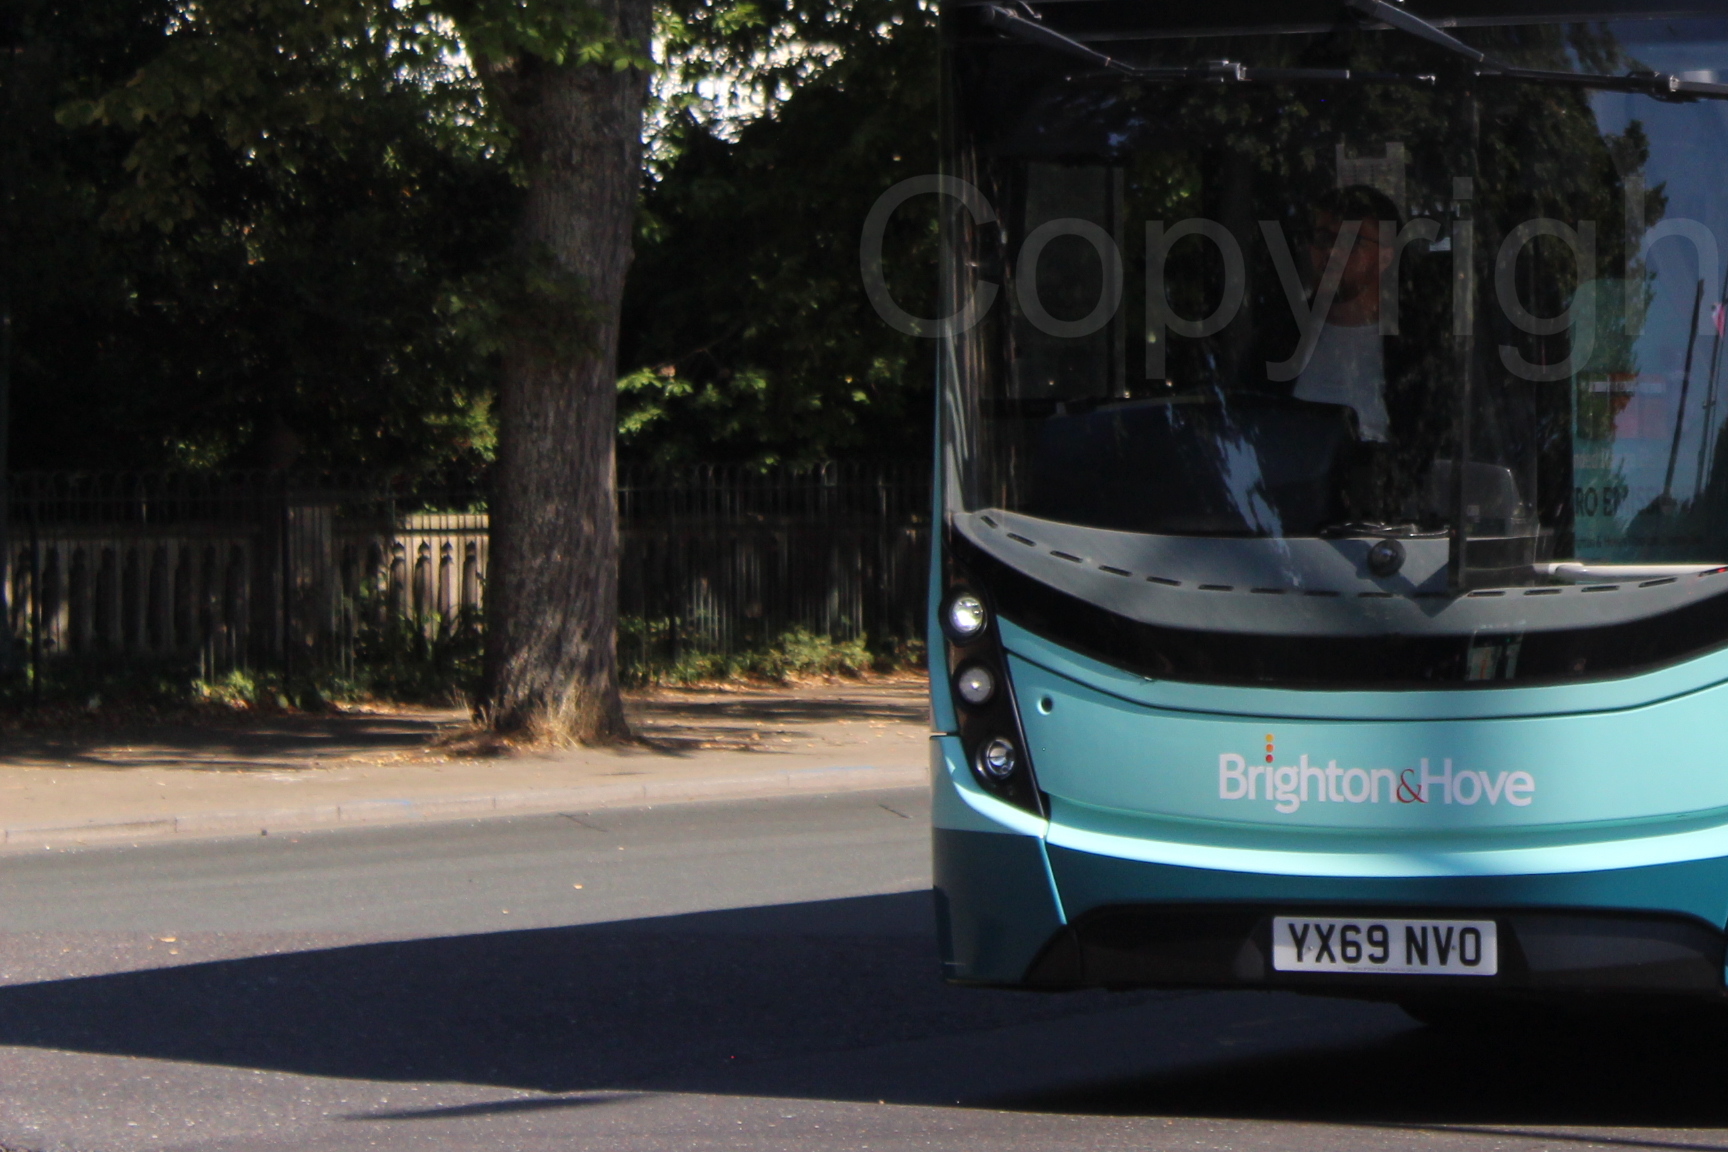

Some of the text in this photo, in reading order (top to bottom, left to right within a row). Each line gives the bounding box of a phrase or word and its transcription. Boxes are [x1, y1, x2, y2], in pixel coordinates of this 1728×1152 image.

[1219, 734, 1536, 815] Brighton&Hove
[1288, 923, 1482, 968] YX69 NVO
